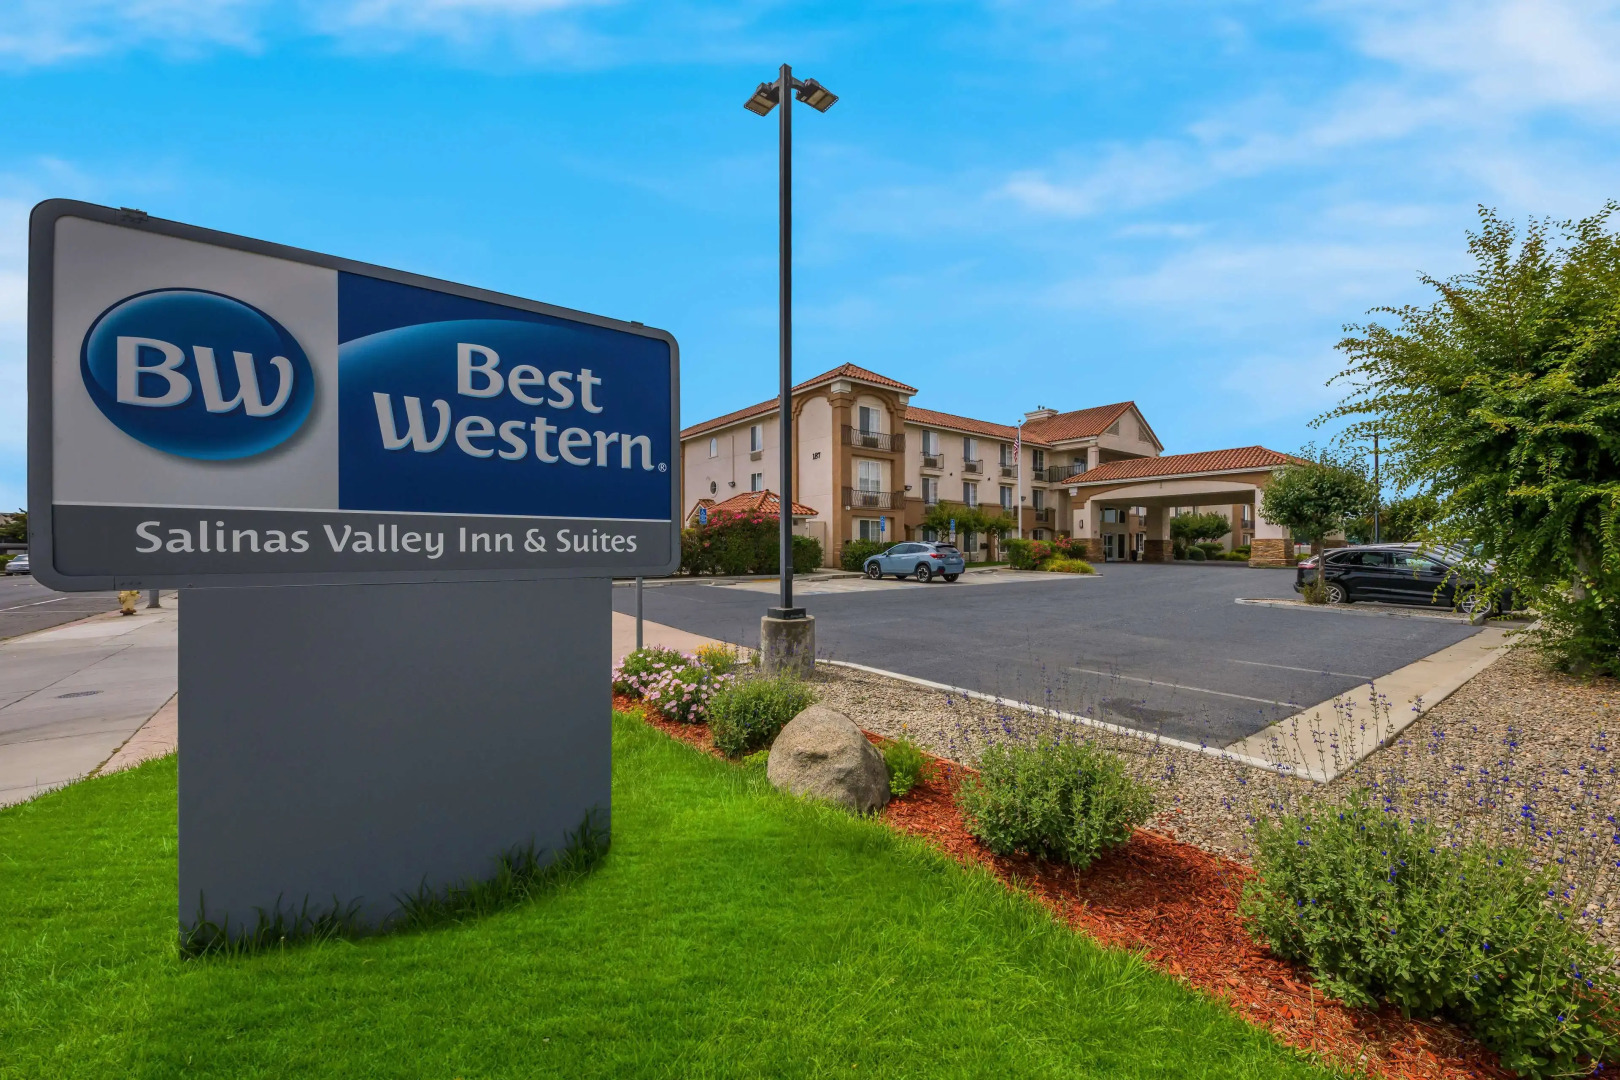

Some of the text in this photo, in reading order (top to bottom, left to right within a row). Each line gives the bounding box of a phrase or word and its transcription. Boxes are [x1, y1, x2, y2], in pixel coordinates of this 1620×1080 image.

[117, 336, 293, 418] BW
[456, 342, 603, 415] Best
[135, 520, 638, 560] Salinas Valley Inn & Suites
